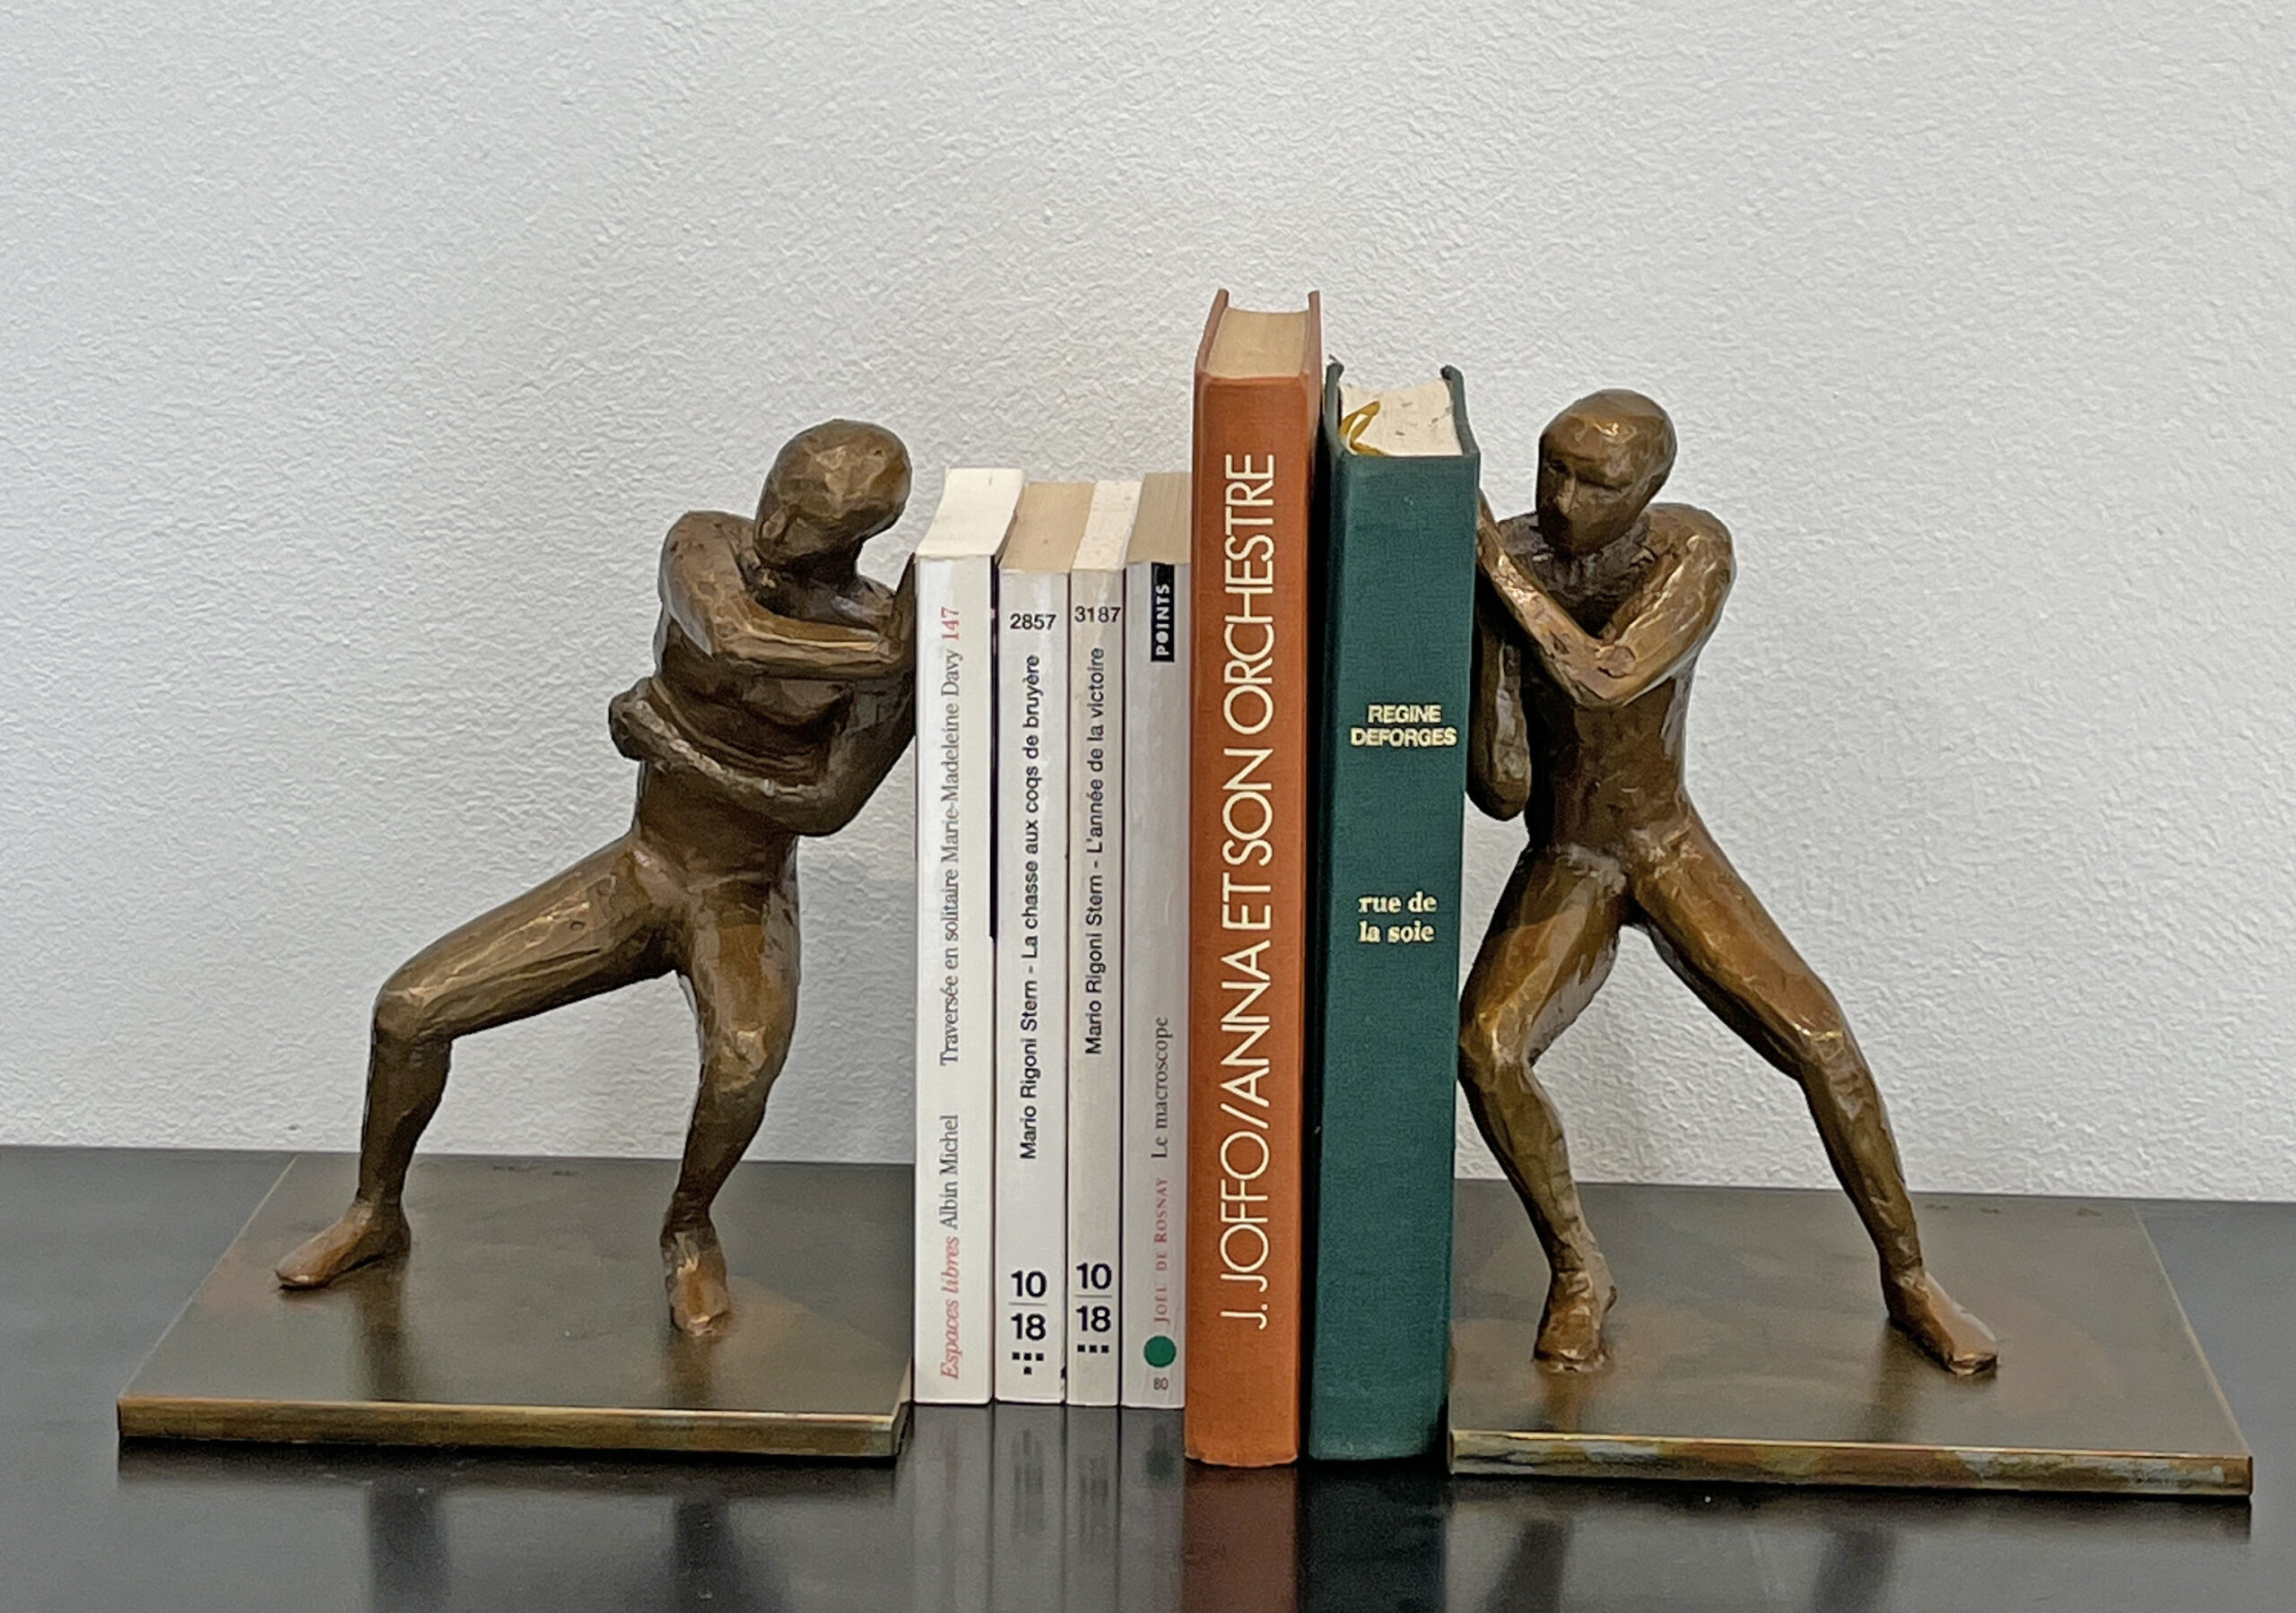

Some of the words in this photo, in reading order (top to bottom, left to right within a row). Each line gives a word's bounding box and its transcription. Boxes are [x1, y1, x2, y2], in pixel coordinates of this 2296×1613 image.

[1074, 605, 1121, 624] 3187
[1154, 583, 1170, 656] POINTS
[1222, 454, 1275, 735] ORCHESTRE
[940, 606, 961, 641] 147
[1009, 612, 1057, 631] 2857
[940, 648, 964, 698] Davy
[1022, 654, 1044, 729] bruyère
[1086, 647, 1105, 719] victoire
[1086, 724, 1104, 741] la
[1350, 727, 1457, 748] DEFORGES
[1367, 704, 1442, 724] REGINE
[1022, 734, 1040, 760] de
[1086, 748, 1104, 773] de
[940, 702, 961, 863] Marie-Madeleine
[1024, 765, 1043, 814] coqs
[1222, 748, 1274, 867] SON
[1024, 819, 1040, 855] aux
[1085, 779, 1104, 854] L'année
[940, 868, 960, 942] solitaire
[1021, 860, 1039, 930] chasse
[1085, 874, 1103, 927] Stern
[1222, 872, 1273, 931] ET
[1357, 895, 1403, 914] rue
[1407, 890, 1438, 913] de
[1021, 934, 1039, 959] La
[1358, 921, 1381, 942] la
[1387, 920, 1435, 942] soie
[944, 946, 960, 970] en
[1084, 932, 1107, 994] Rigoni
[939, 975, 960, 1067] Traversée
[1020, 980, 1039, 1032] Stern
[1084, 1000, 1103, 1055] Mario
[1020, 1038, 1041, 1099] Rigoni
[1153, 1017, 1174, 1130] macroscope
[939, 1114, 960, 1176] Michel
[1019, 1105, 1039, 1159] Mario
[1150, 1136, 1169, 1158] Le
[939, 1181, 960, 1230] Albin
[1153, 1177, 1169, 1244] ROSNAY
[940, 1236, 960, 1294] libres
[1010, 1270, 1048, 1299] 10
[1075, 1262, 1113, 1291] 10
[1155, 1252, 1168, 1272] DE
[940, 1299, 964, 1381] Espaces
[1010, 1312, 1047, 1342] 18
[1075, 1305, 1112, 1333] 18
[1220, 1304, 1269, 1331] J.
